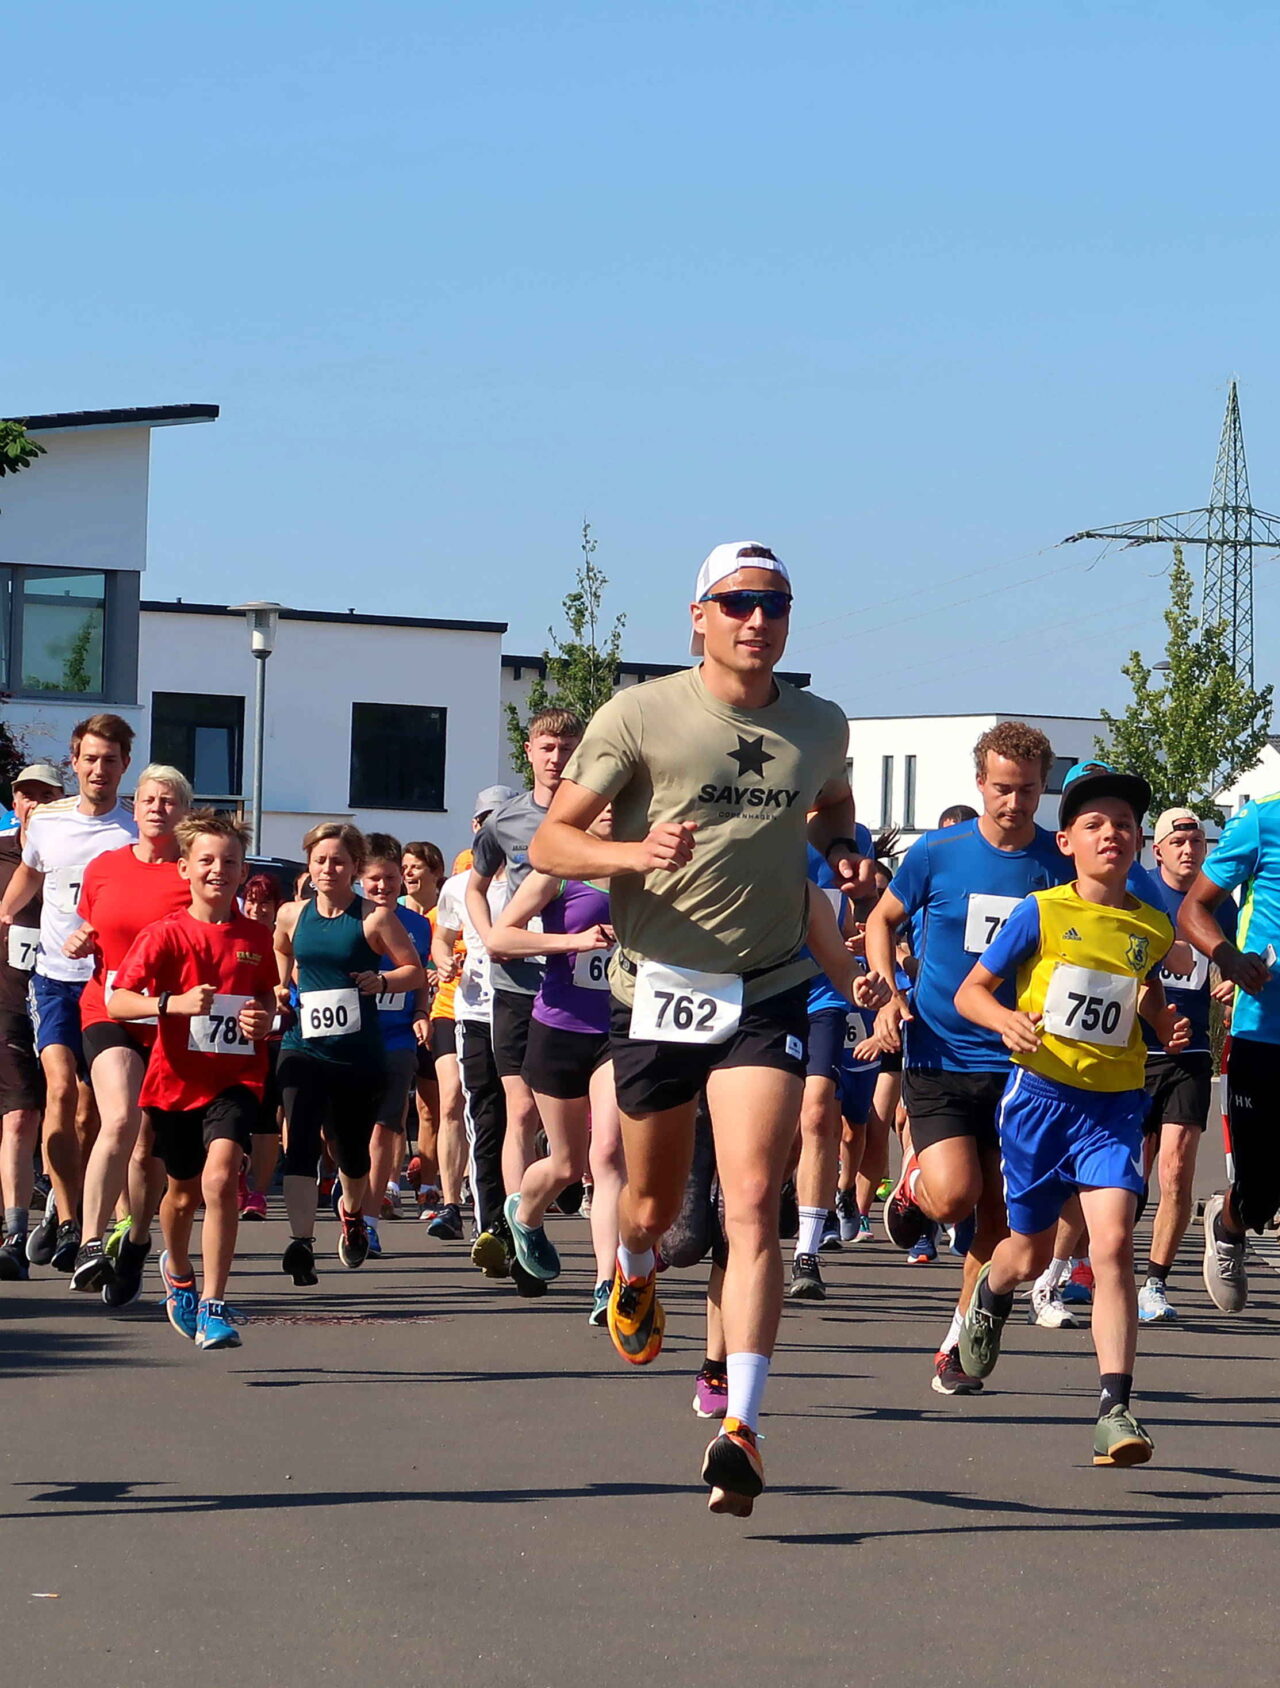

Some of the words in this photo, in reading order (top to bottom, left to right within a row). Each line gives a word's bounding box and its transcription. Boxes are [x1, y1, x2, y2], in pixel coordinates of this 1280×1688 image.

[698, 784, 801, 808] SAYSKY
[984, 916, 1008, 945] 7
[310, 1005, 349, 1030] 690
[653, 990, 718, 1033] 762
[1065, 991, 1122, 1034] 750
